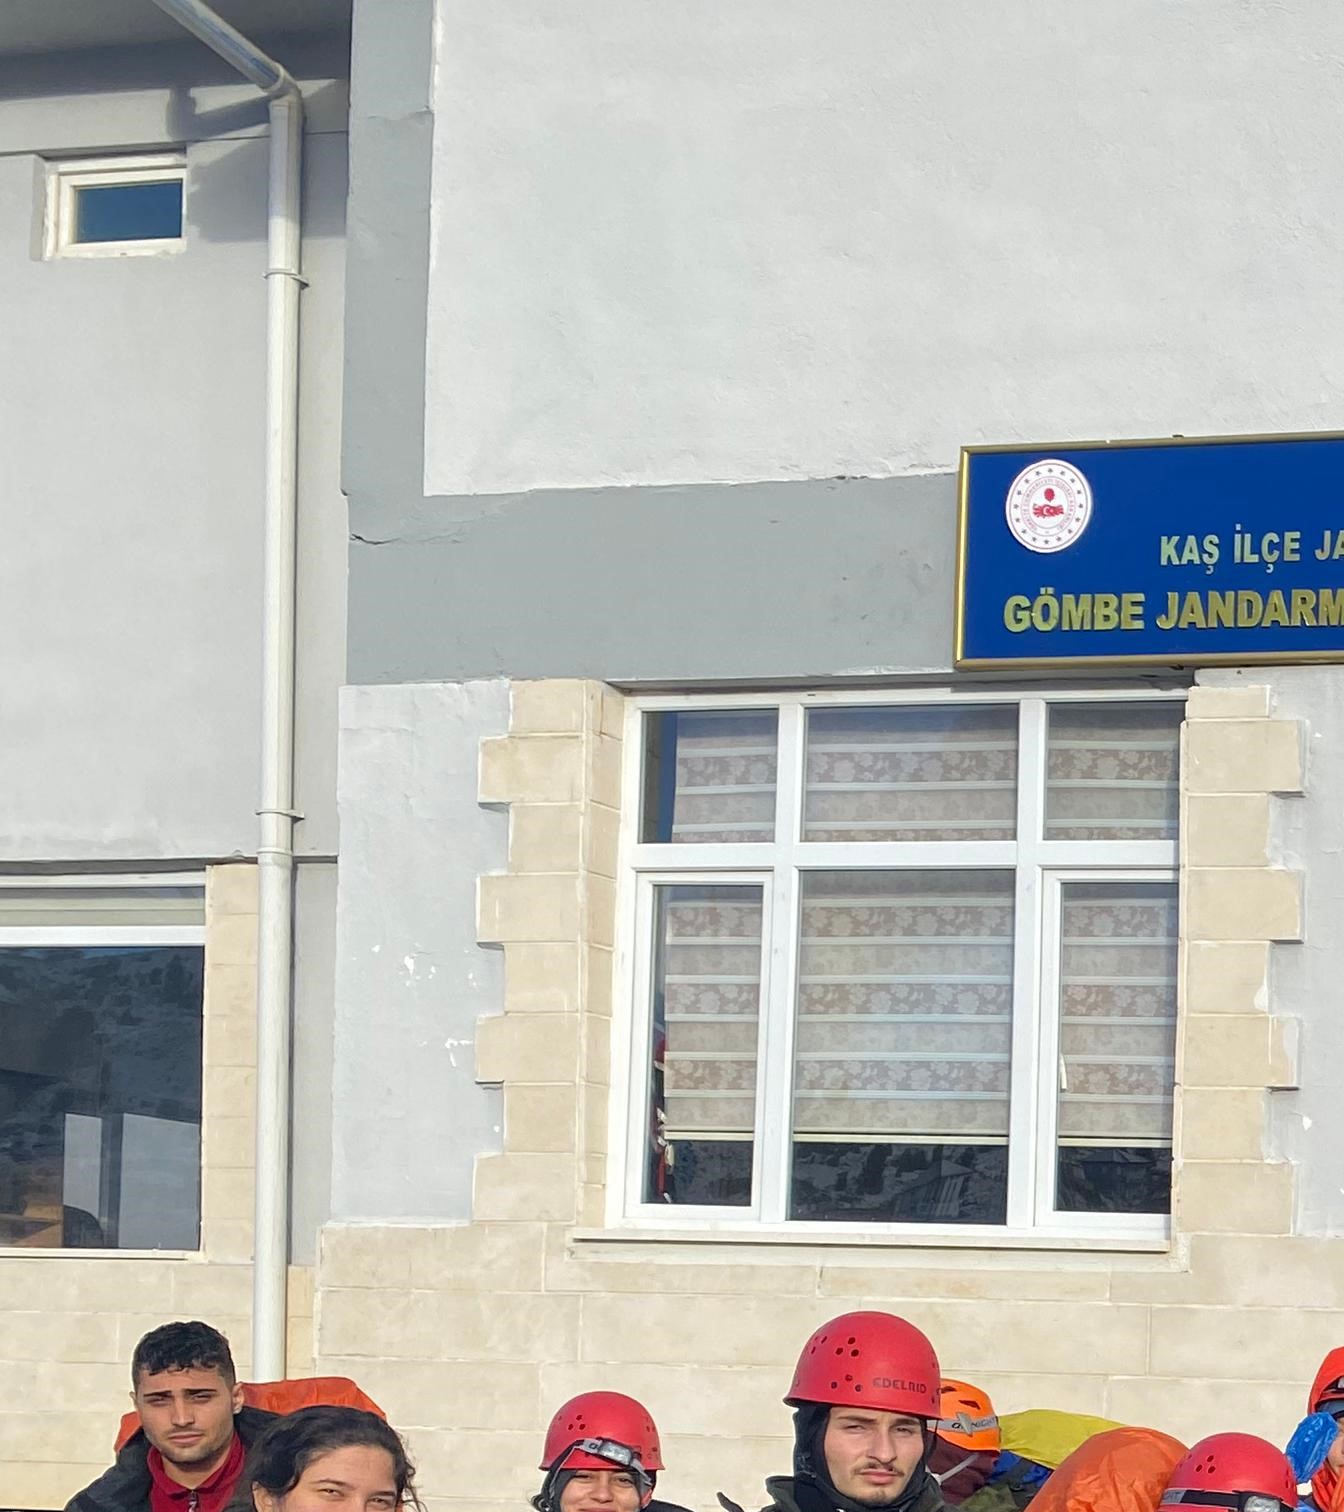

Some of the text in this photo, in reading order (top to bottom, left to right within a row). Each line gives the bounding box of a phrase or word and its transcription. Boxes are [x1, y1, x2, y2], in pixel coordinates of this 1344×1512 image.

[1160, 534, 1220, 575] KAŞ
[1234, 524, 1301, 573] İLÇE
[1004, 587, 1145, 633] GÖMBE
[872, 1377, 927, 1394] EDELRID
